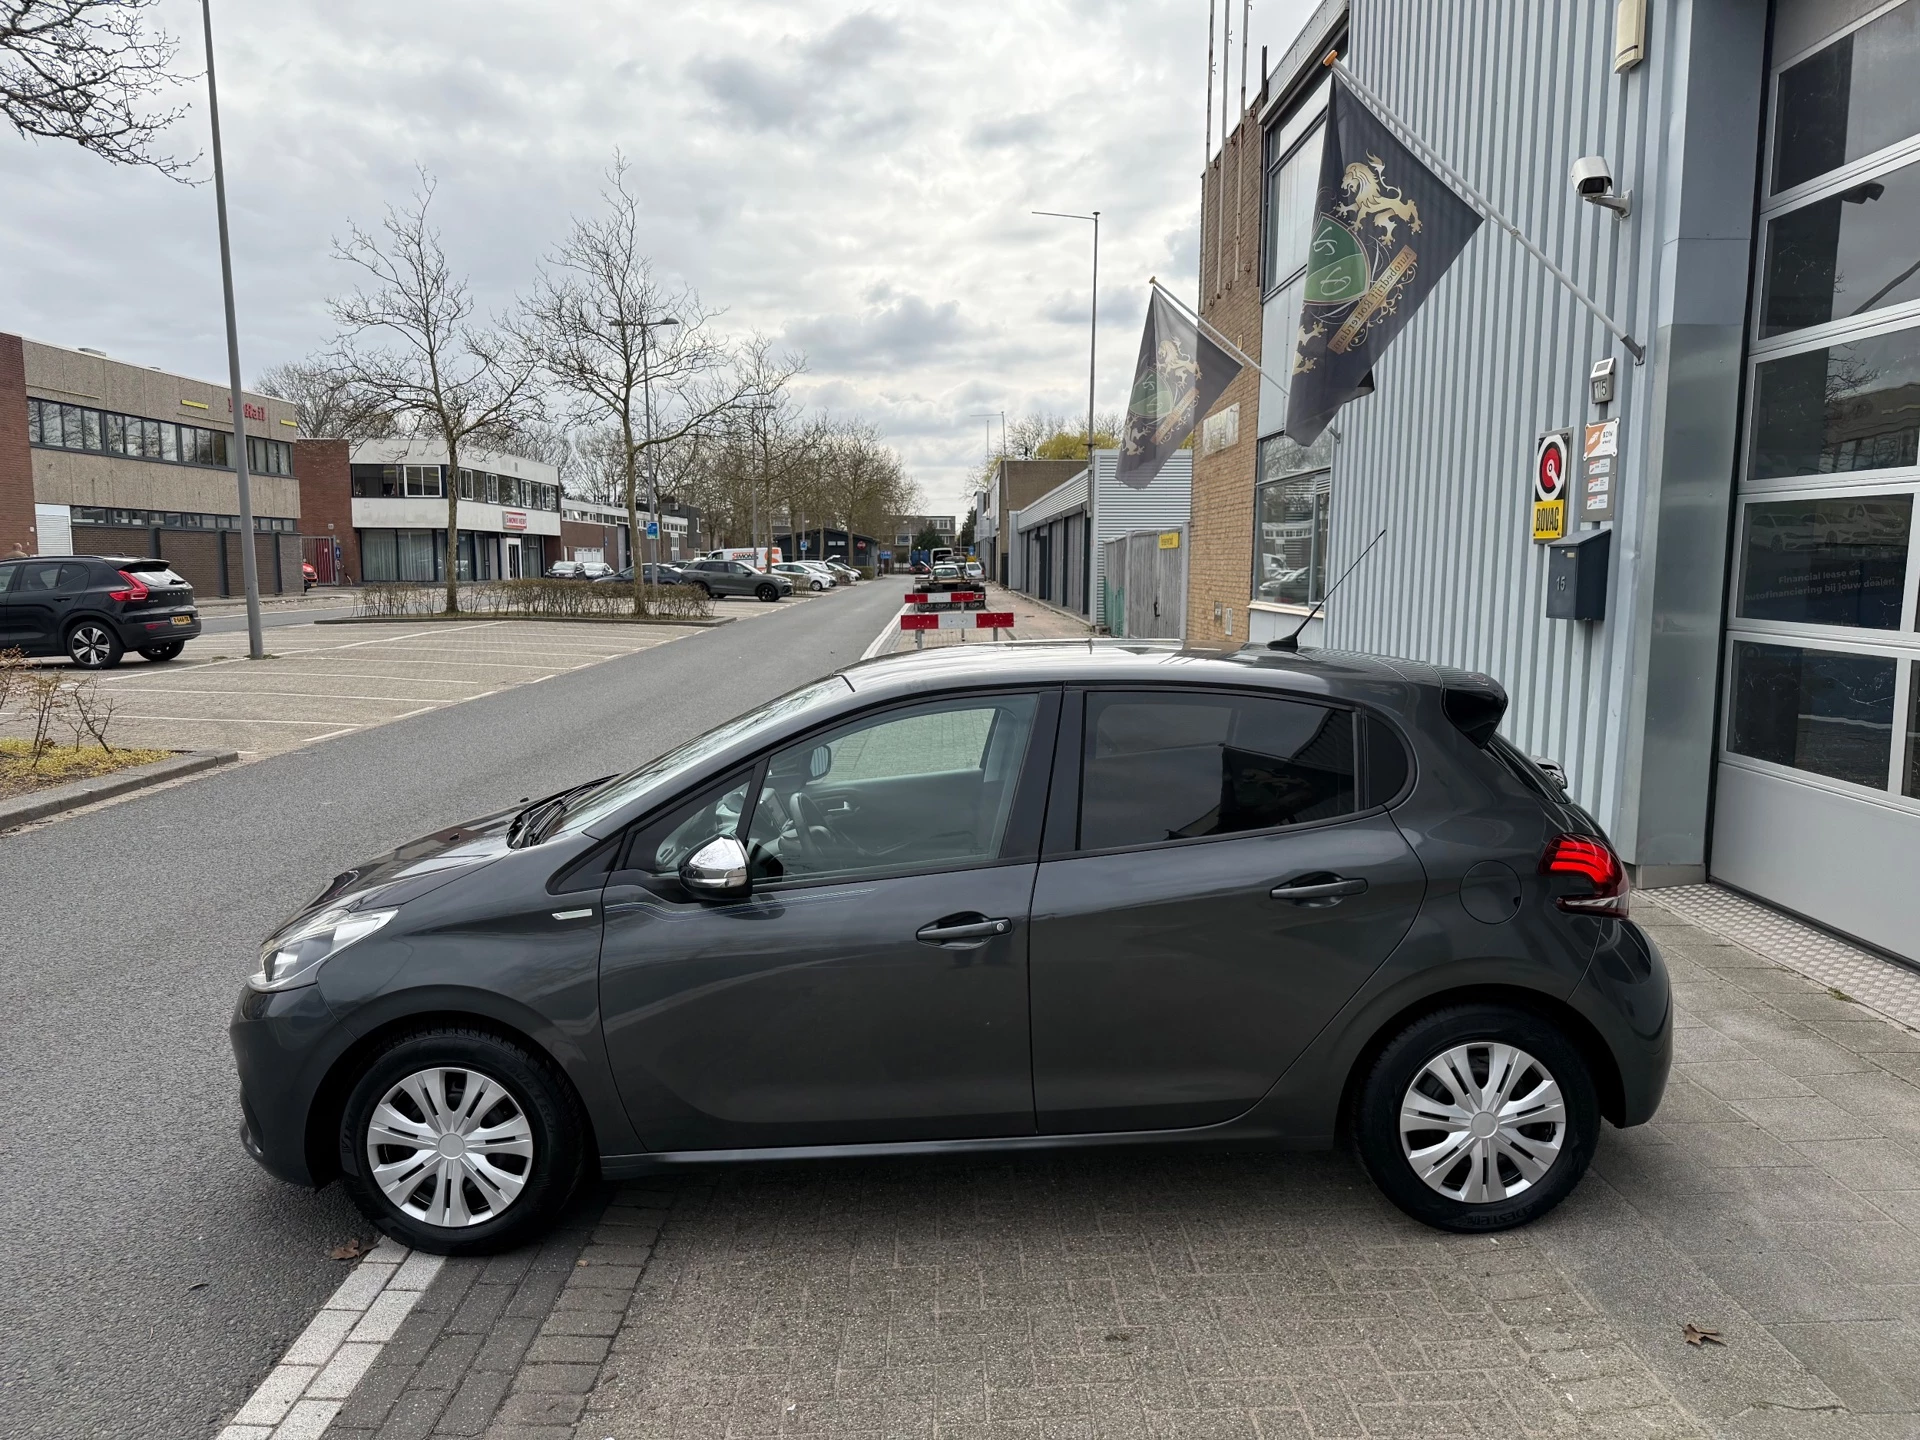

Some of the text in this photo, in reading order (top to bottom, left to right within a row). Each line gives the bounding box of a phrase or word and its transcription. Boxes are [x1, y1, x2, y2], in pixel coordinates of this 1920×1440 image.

[1595, 380, 1607, 398] 15
[228, 397, 265, 421] Rail
[1535, 507, 1560, 532] BOVAG
[1555, 575, 1566, 591] 15
[1778, 568, 1861, 584] Financial lease en
[1824, 583, 1836, 593] bij
